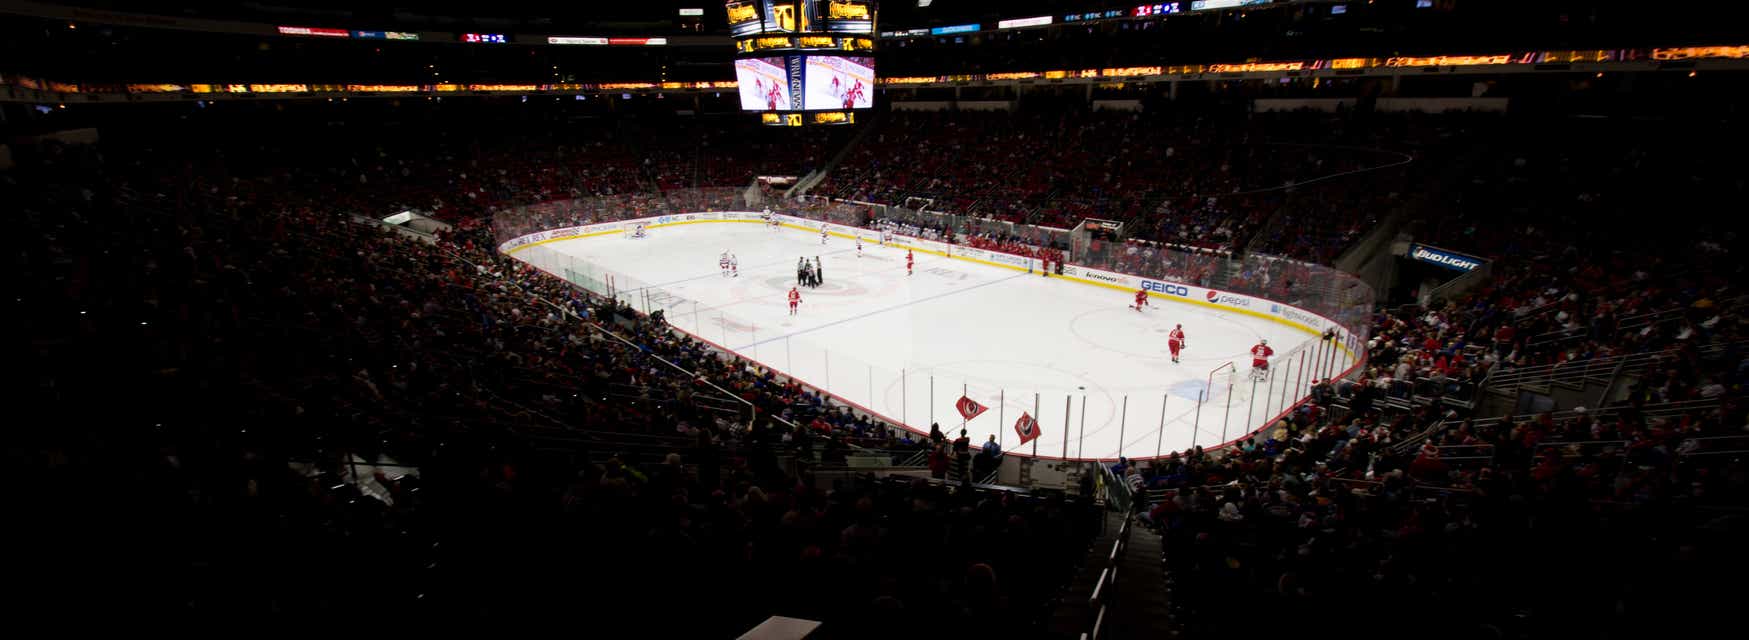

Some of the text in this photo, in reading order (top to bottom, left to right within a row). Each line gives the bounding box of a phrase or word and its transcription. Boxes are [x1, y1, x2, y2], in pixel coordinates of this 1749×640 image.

[1416, 248, 1480, 271] BUD LIGHT
[1085, 271, 1118, 283] lenovo
[1140, 279, 1189, 297] GEICO
[1219, 294, 1251, 307] pepsi
